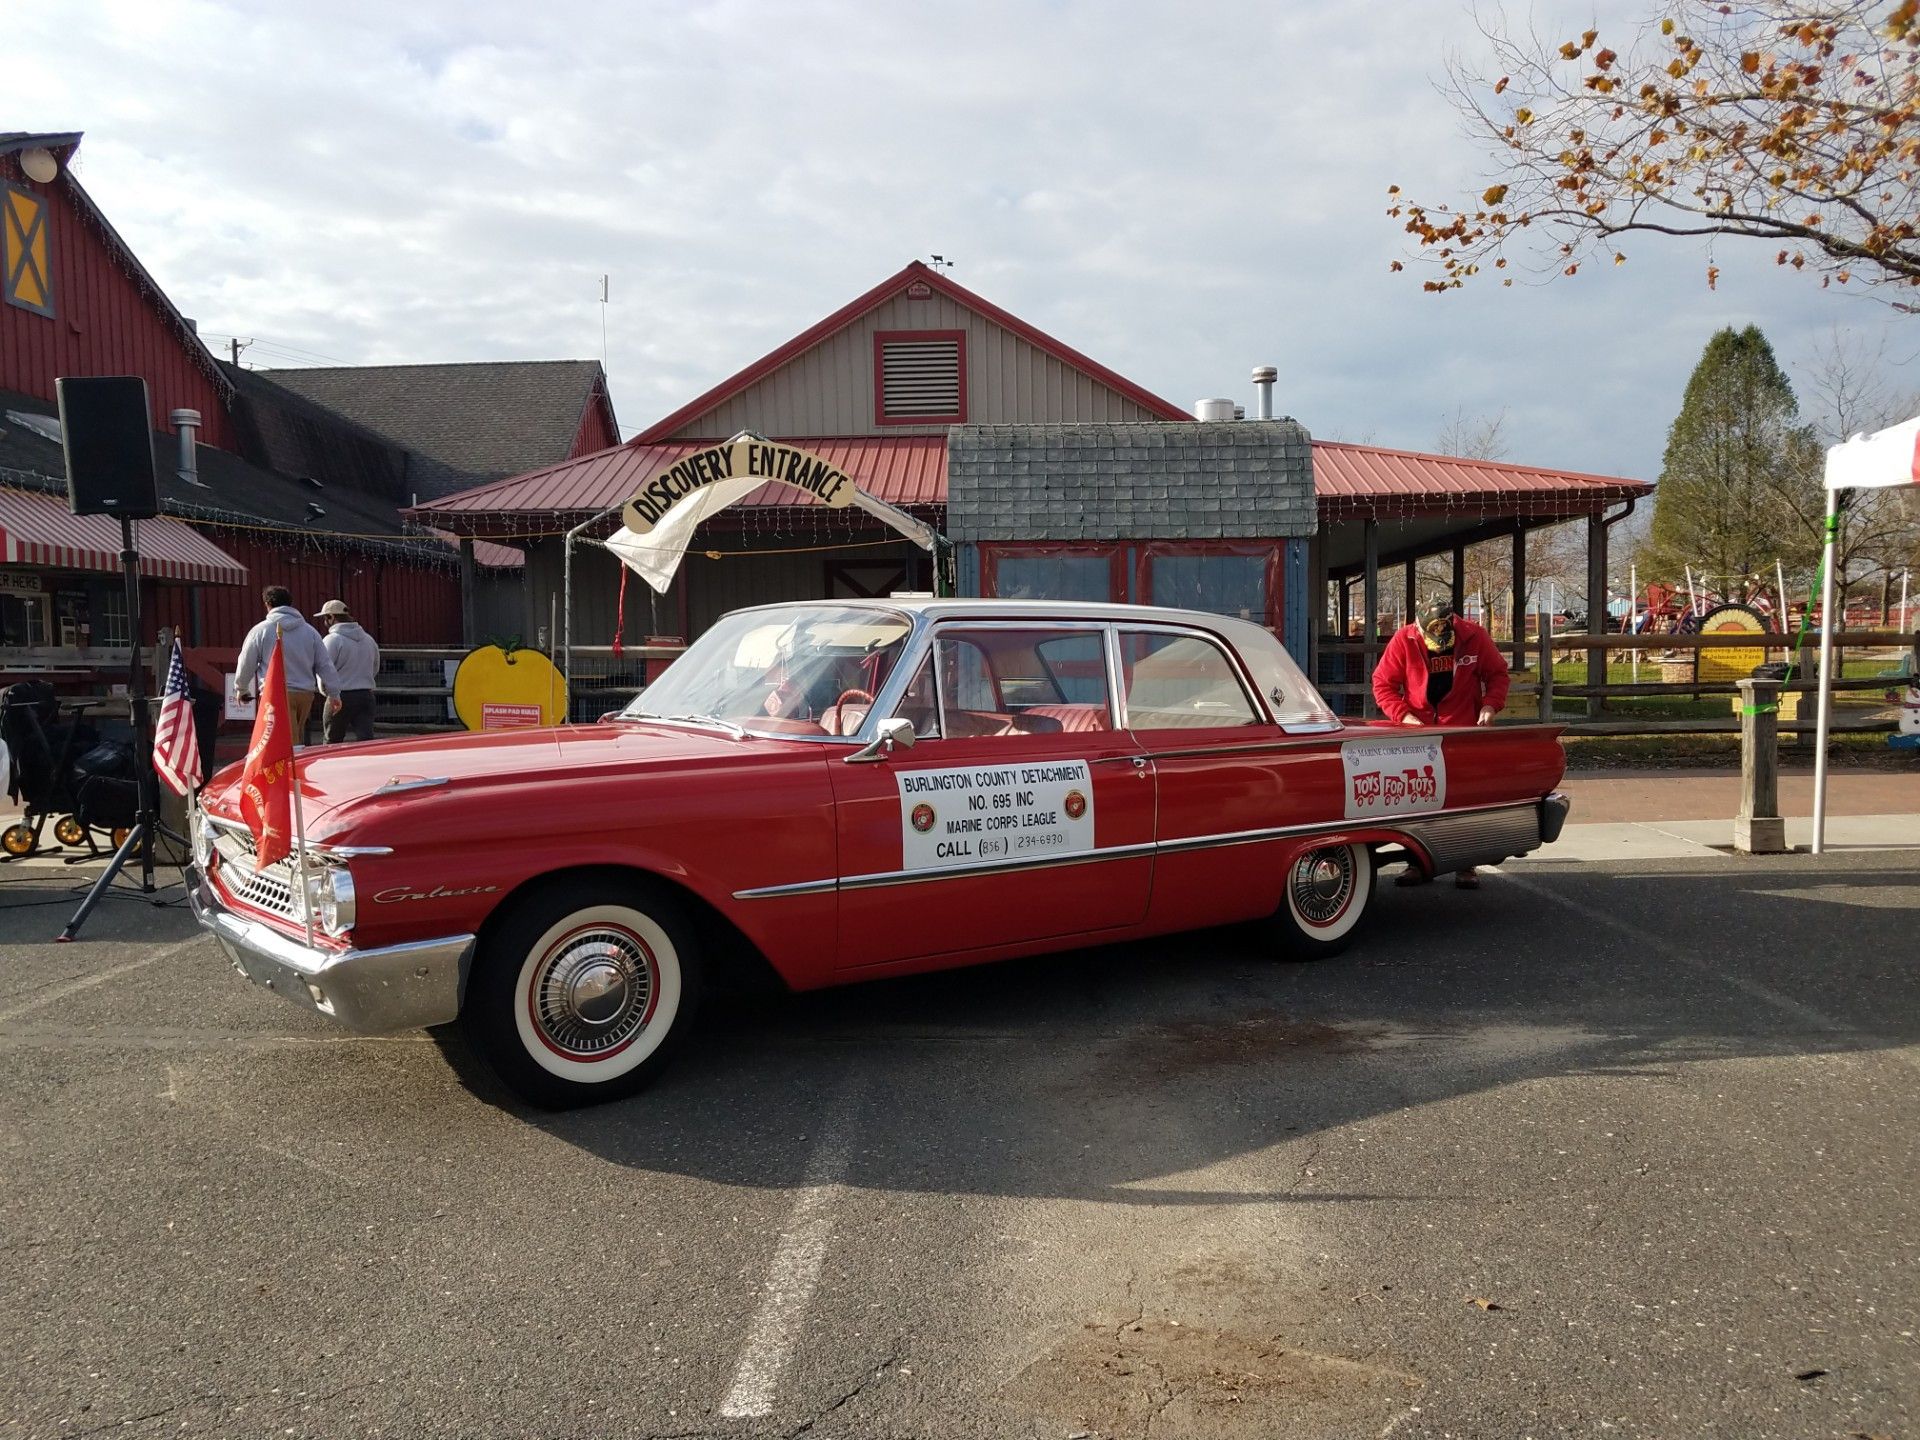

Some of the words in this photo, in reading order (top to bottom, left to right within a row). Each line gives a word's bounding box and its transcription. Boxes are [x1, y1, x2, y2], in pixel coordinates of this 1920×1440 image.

[632, 444, 734, 526] DISCOVERY
[748, 444, 848, 503] ENTRANCE
[13, 574, 38, 589] HERE
[1357, 747, 1382, 756] MARINE
[1383, 746, 1402, 755] CORPS
[1402, 745, 1426, 754] RESERVE
[904, 774, 972, 793] BURLINGTON
[975, 770, 1017, 787] COUNTY
[1021, 766, 1085, 784] DETACHMENT
[1355, 775, 1379, 794] TOYS
[1385, 778, 1404, 794] FOR
[1409, 777, 1434, 794] TOTS
[968, 794, 988, 811] NO.
[992, 793, 1011, 809] 695
[1016, 790, 1034, 807] INC
[946, 818, 982, 834] MARINE
[986, 815, 1018, 830] CORPS
[1022, 811, 1057, 827] LEAGUE
[936, 840, 972, 858] CALL
[1017, 833, 1063, 849] 234-6930
[373, 885, 504, 903] Galaxie
